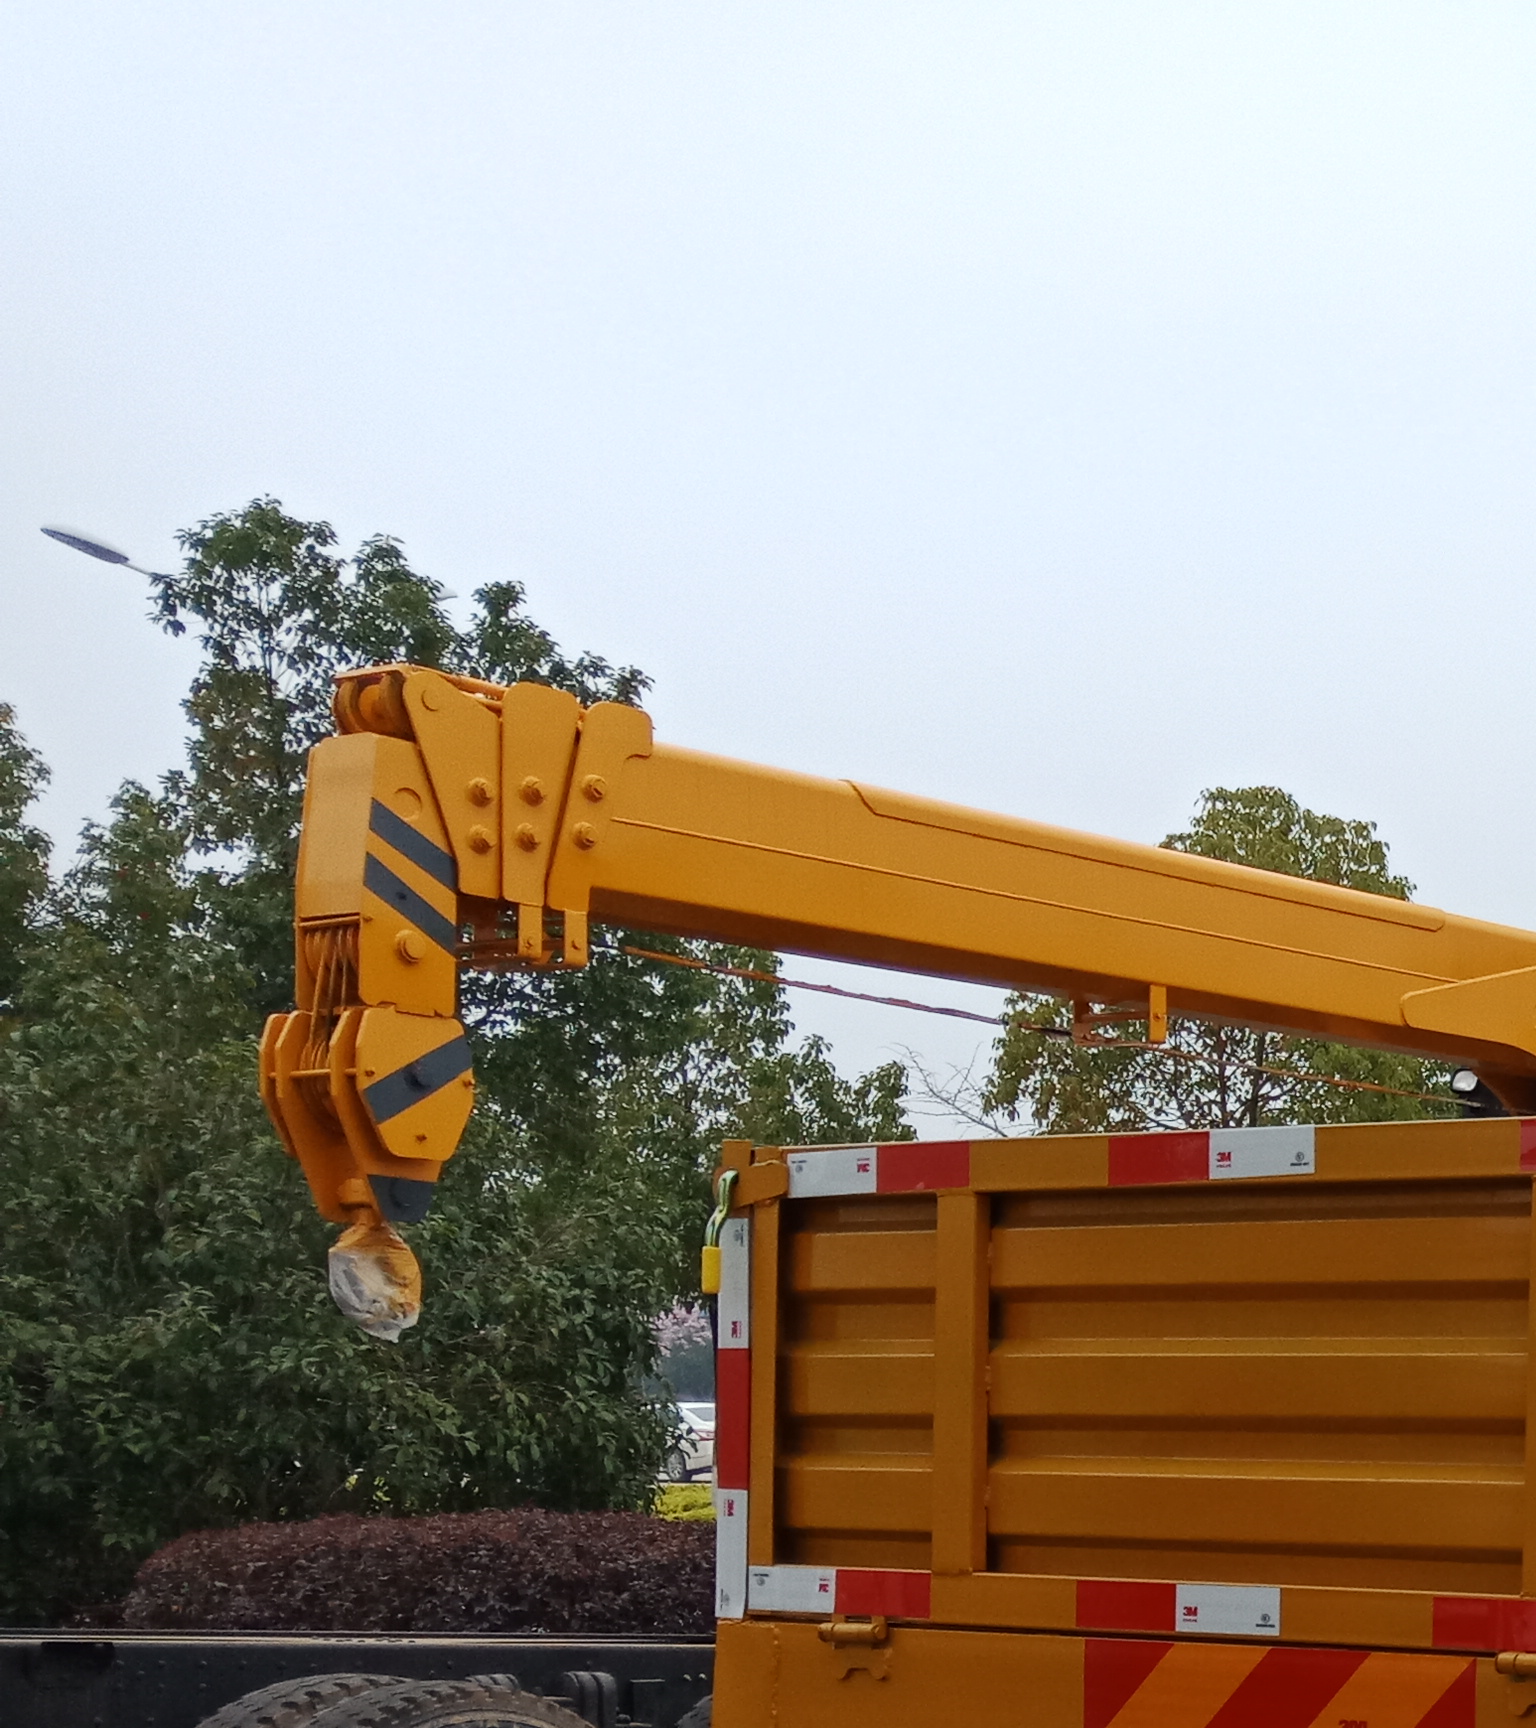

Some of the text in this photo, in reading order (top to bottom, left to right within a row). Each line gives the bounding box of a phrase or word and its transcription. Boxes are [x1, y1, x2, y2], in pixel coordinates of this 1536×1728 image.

[1216, 1152, 1232, 1162] 3M
[727, 1499, 734, 1516] 3M
[1183, 1606, 1198, 1617] 3M
